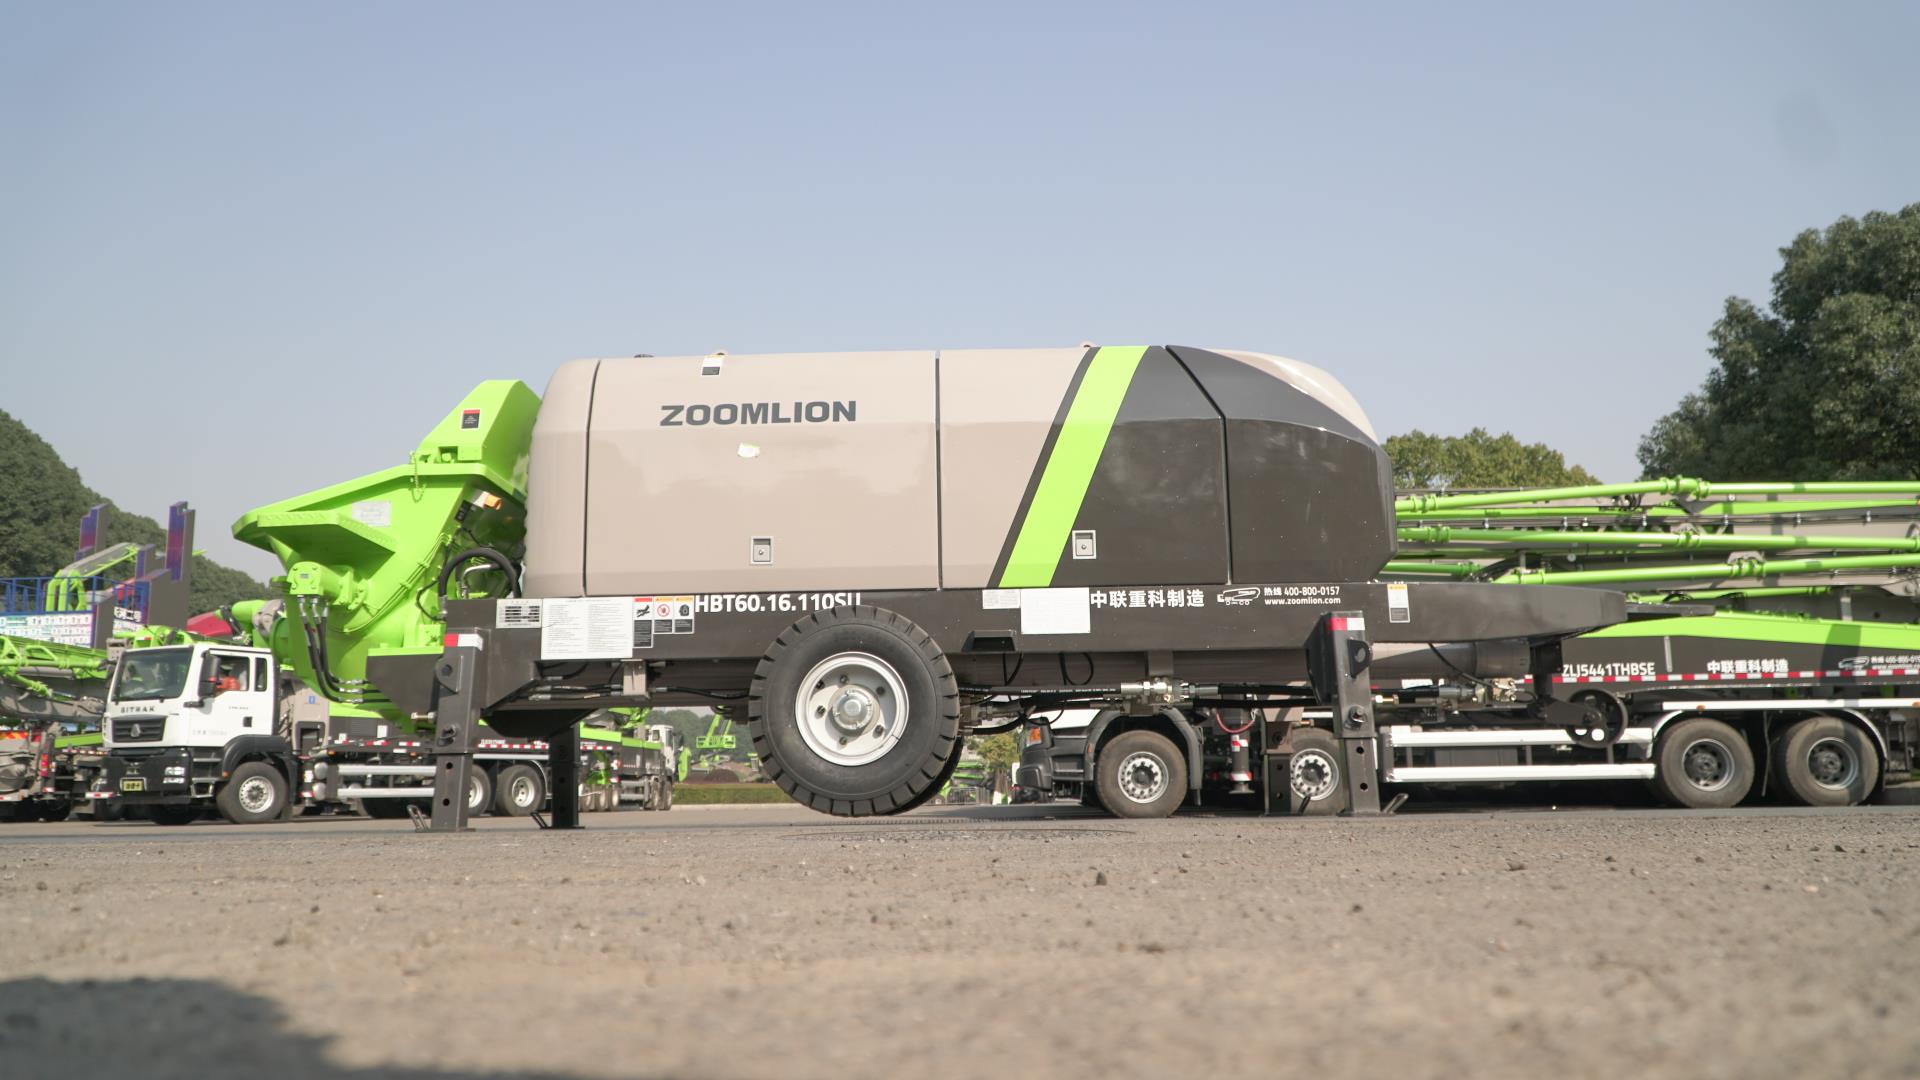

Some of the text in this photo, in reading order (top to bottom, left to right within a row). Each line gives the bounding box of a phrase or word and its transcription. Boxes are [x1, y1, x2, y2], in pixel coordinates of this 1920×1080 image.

[660, 400, 857, 427] ZOOMLION
[1090, 588, 1205, 608] 中联重科制造
[1284, 586, 1340, 596] 400-800-0157
[1264, 596, 1341, 606] www.zoomlion.com
[1562, 662, 1656, 677] ZLJ5441THBSE
[1707, 658, 1789, 673] 中联重科制造
